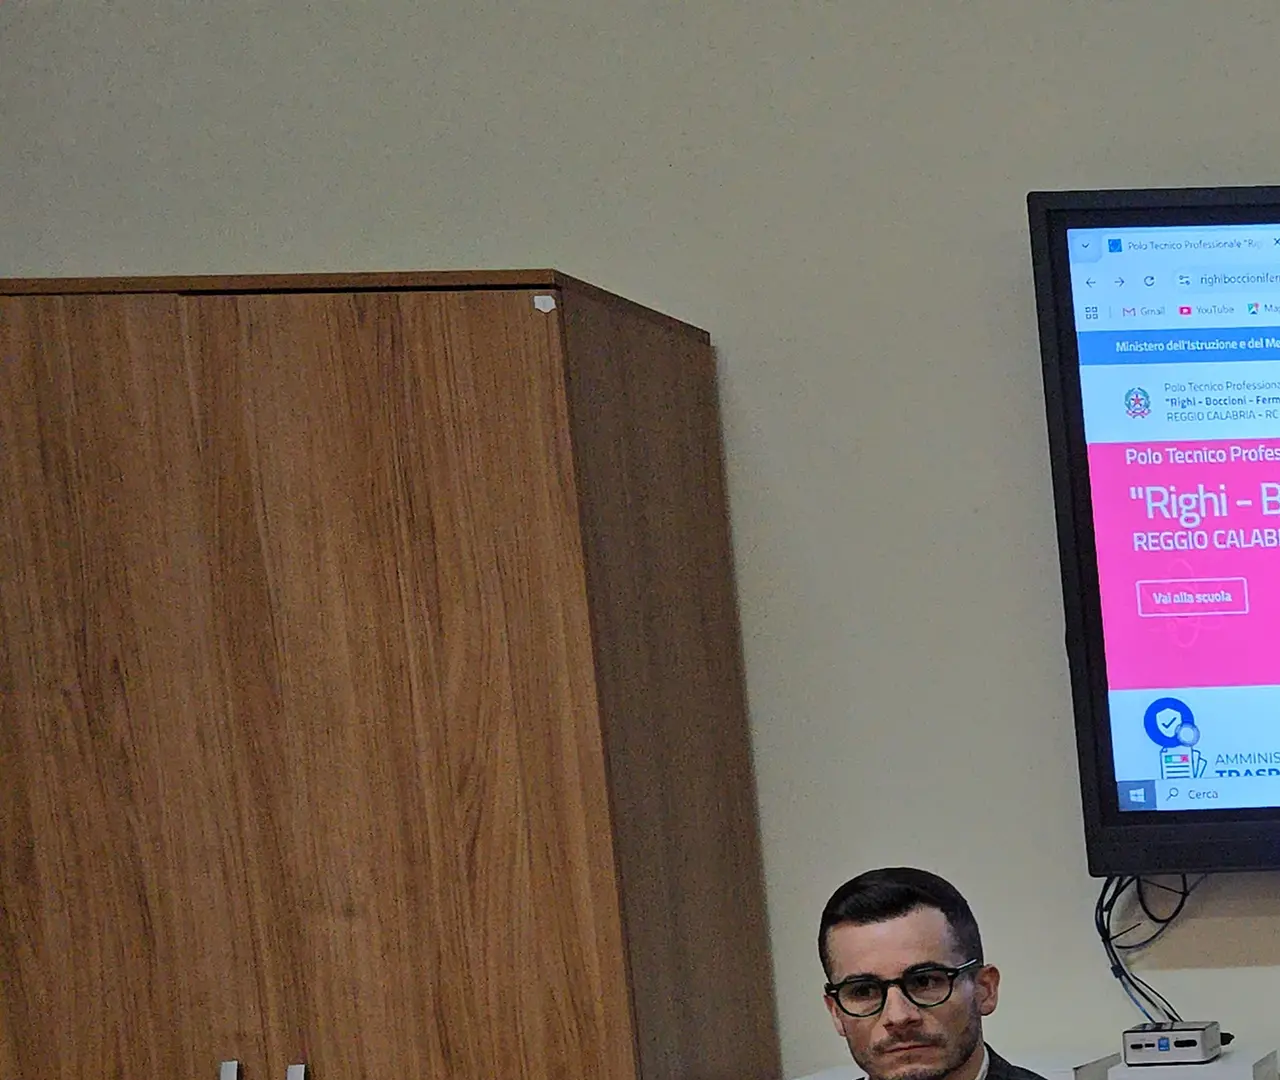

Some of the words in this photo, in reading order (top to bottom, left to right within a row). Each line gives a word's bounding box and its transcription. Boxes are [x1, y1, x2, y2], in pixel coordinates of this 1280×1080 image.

[1150, 240, 1182, 250] Tecnico
[1184, 239, 1242, 250] Professionale
[1140, 306, 1166, 316] Gmail
[1196, 304, 1235, 314] YouTube
[1116, 341, 1164, 352] Ministero
[1166, 339, 1238, 351] dell'Istruzione
[1248, 338, 1264, 349] del
[1164, 383, 1186, 393] Polo
[1188, 382, 1224, 392] Tecnico
[1166, 398, 1196, 409] "Righi
[1204, 396, 1247, 406] Boccioni
[1166, 412, 1204, 422] REGGIO
[1206, 410, 1256, 421] CALABRIA
[1266, 409, 1279, 419] RC
[1126, 448, 1163, 464] Polo
[1165, 446, 1226, 464] Tecnico
[1129, 484, 1229, 528] "Righi
[1132, 531, 1208, 551] REGGIO
[1152, 592, 1172, 605] Vai
[1174, 592, 1194, 604] alla
[1196, 590, 1232, 604] scuola
[1188, 788, 1219, 800] Cerca
